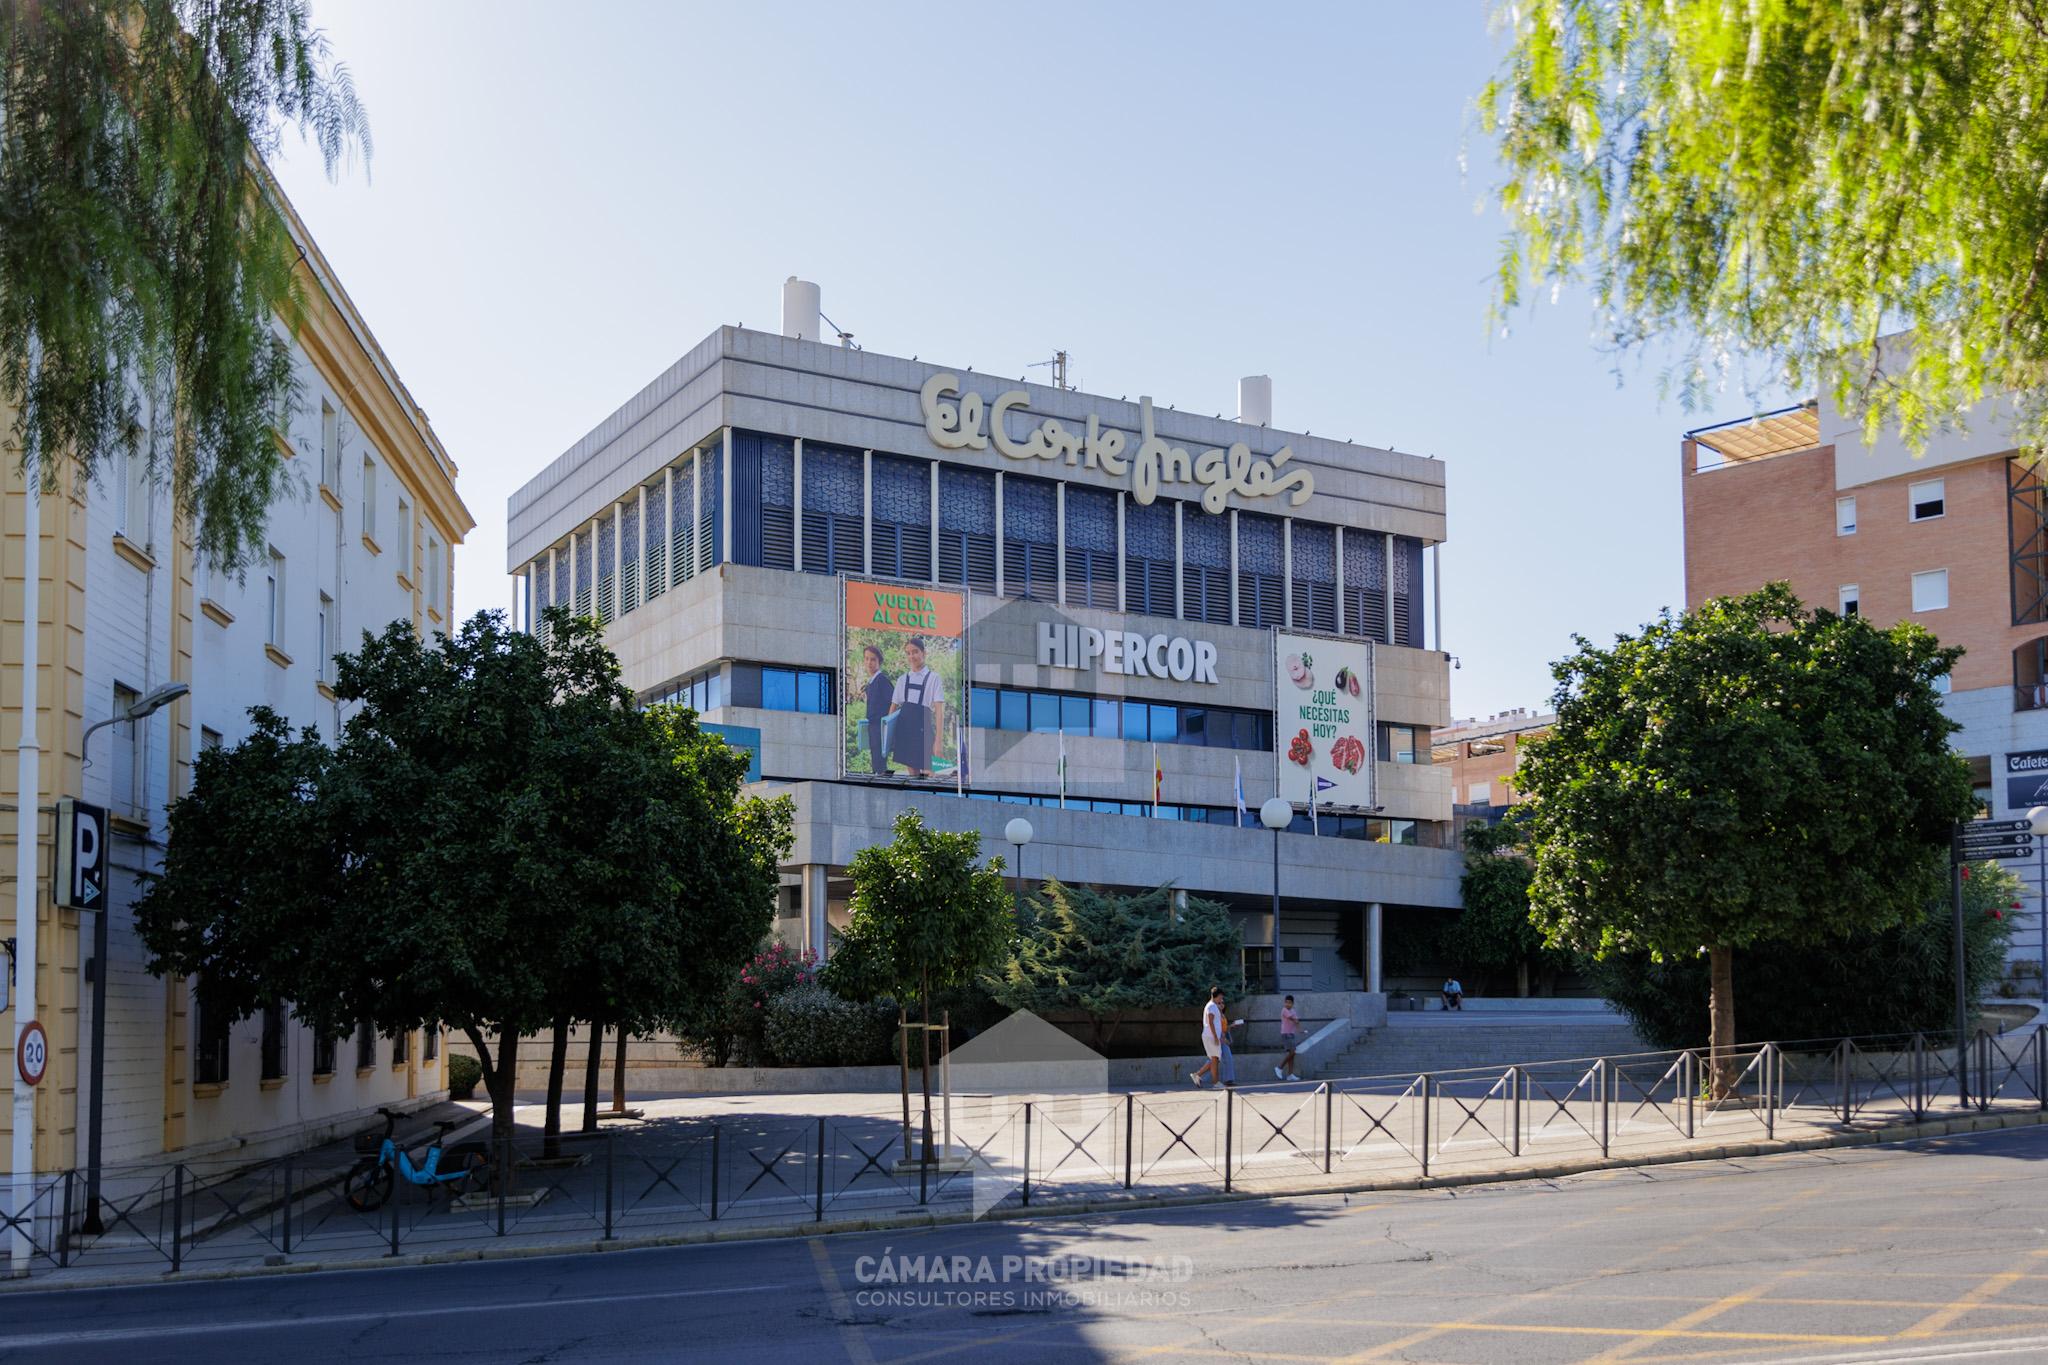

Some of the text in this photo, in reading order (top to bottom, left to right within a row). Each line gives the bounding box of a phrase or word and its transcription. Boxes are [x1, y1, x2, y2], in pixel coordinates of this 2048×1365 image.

[920, 373, 1315, 515] El Corte Inglés
[874, 591, 935, 612] VUELTA
[873, 608, 894, 624] AL
[898, 611, 937, 629] COLE
[1036, 621, 1219, 684] HIPERCOR
[1312, 689, 1337, 707] ¿QUÉ
[1300, 705, 1350, 724] NECESITAS
[1312, 723, 1337, 739] HOY?
[75, 811, 99, 897] P
[26, 1042, 43, 1063] 20
